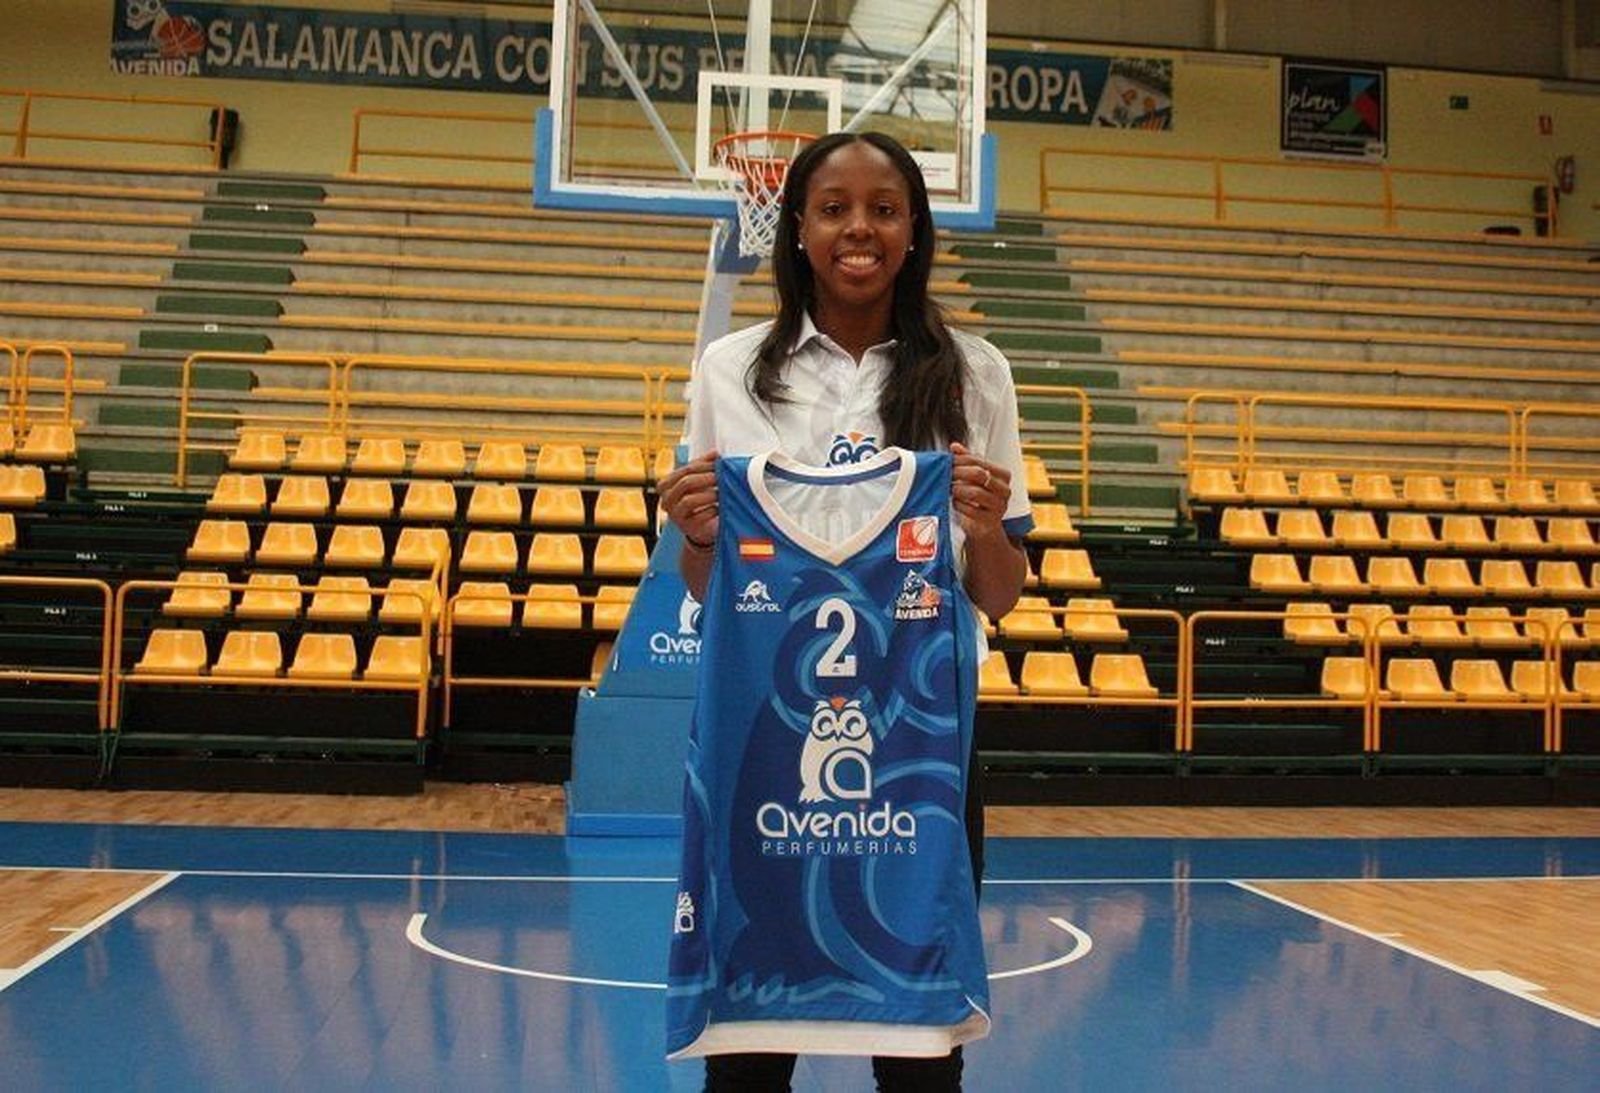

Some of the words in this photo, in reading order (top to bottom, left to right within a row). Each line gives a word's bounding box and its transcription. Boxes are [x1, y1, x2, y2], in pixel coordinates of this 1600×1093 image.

[111, 57, 200, 76] AVENIDA
[206, 19, 481, 80] SALAMANCA
[601, 43, 685, 92] SUS
[985, 64, 1089, 115] ROPA
[1285, 85, 1340, 115] plan
[815, 598, 857, 677] 2
